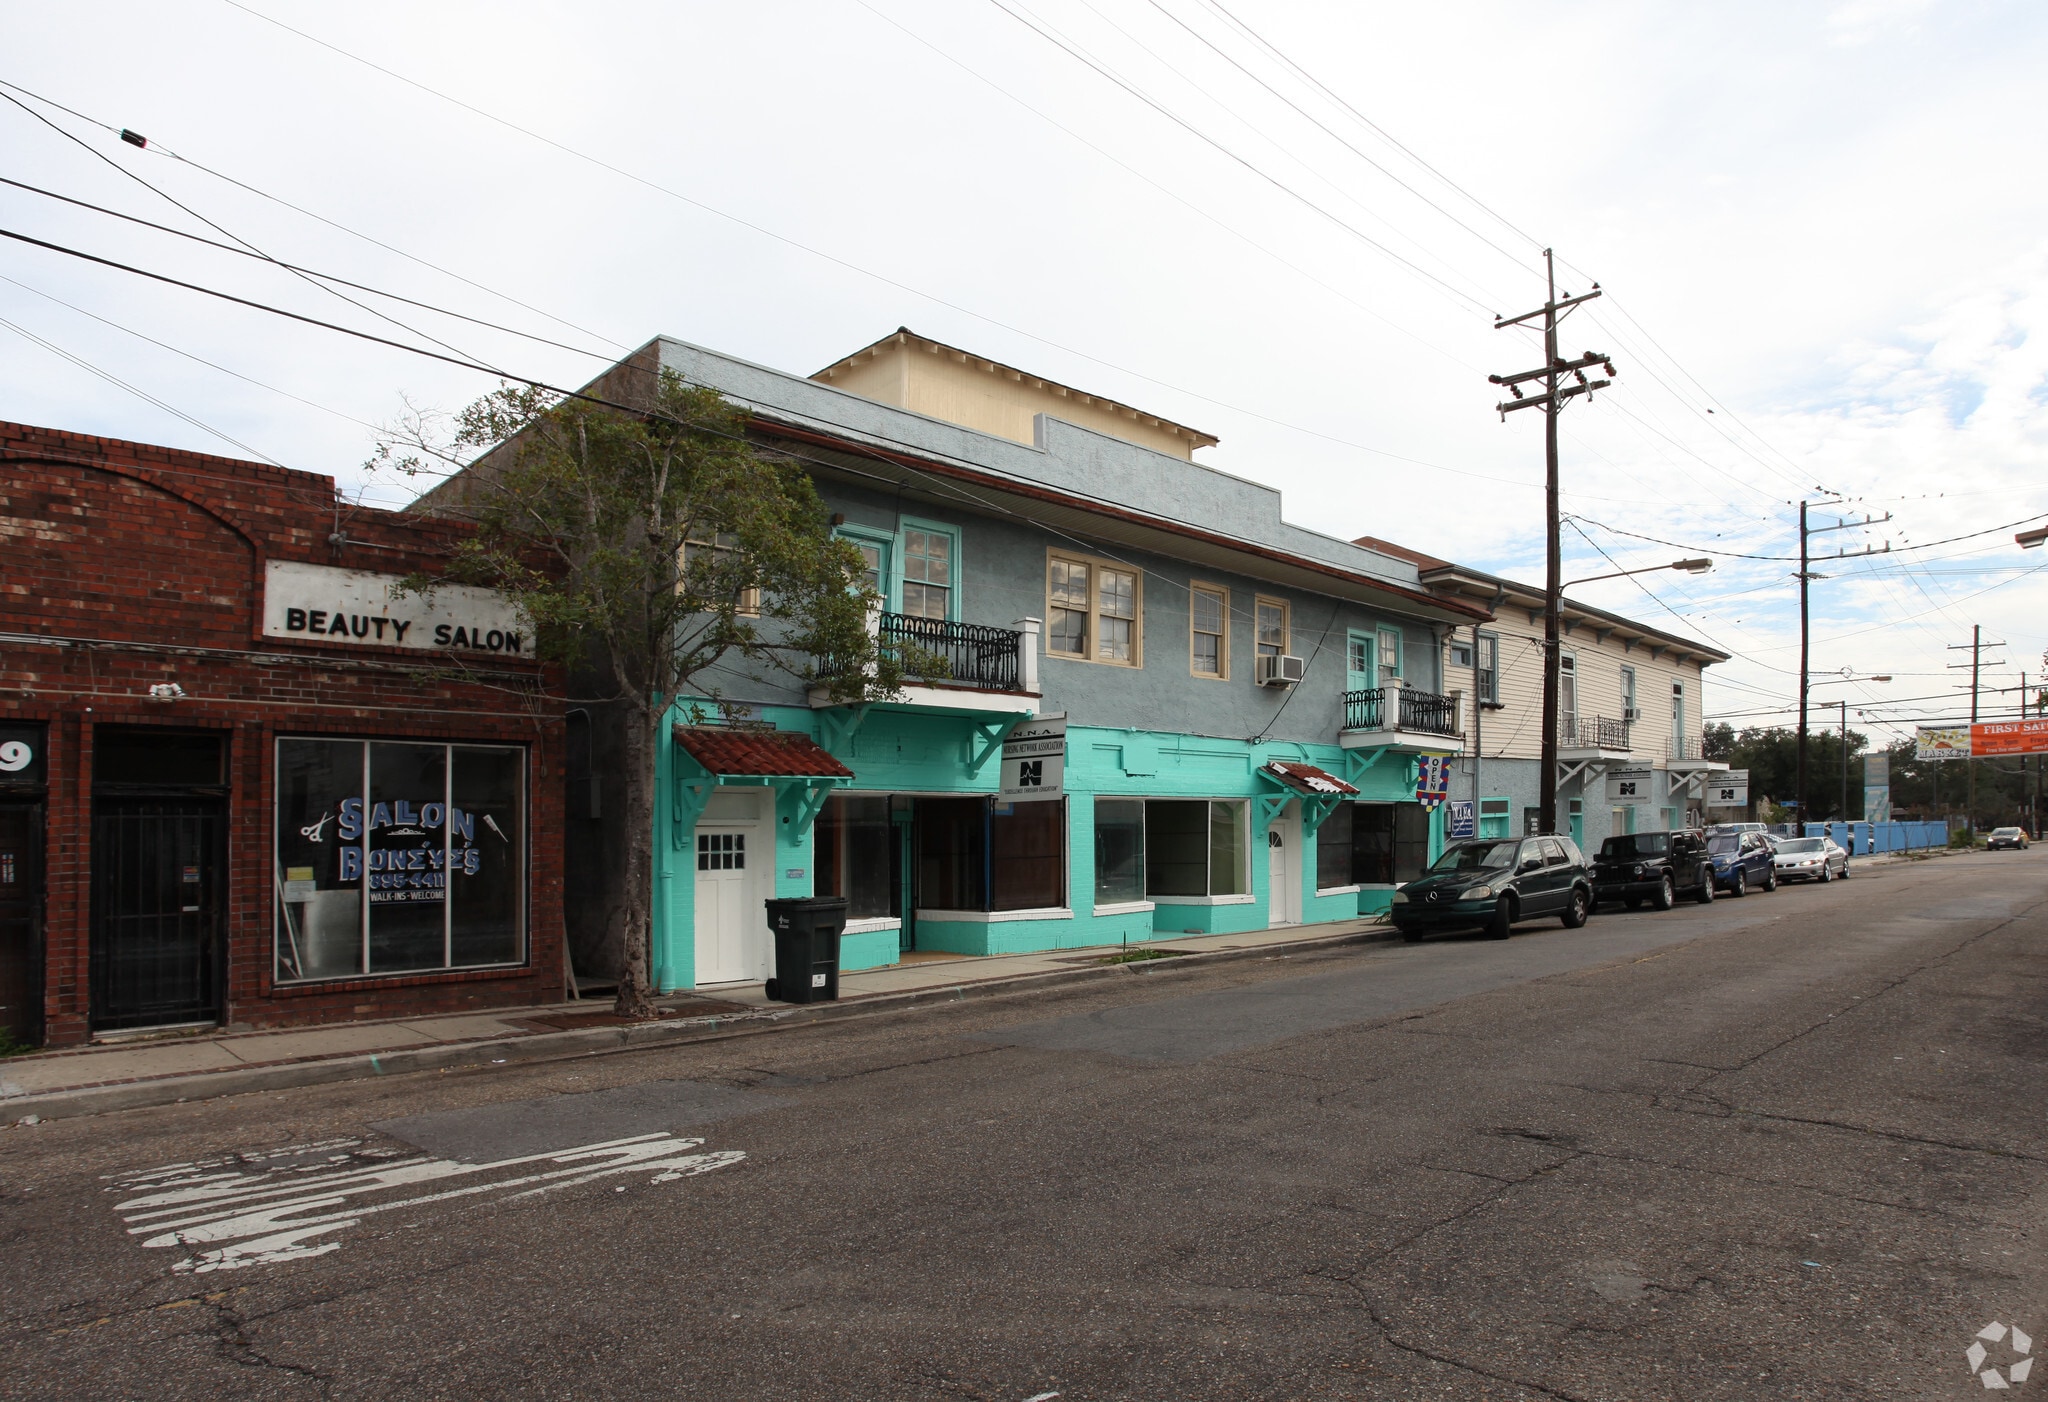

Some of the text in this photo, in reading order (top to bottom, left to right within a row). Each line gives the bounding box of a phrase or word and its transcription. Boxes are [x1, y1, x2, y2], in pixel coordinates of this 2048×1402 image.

[286, 607, 521, 651] BEAUTY SALON
[1013, 729, 1057, 738] N.N.A.
[1983, 724, 2019, 735] FIRST
[1038, 741, 1064, 752] ASSOCIATION
[1919, 748, 1969, 758] MARKET
[0, 741, 32, 771] 9
[1430, 758, 1440, 790] OPEN
[369, 872, 445, 890] 895-4411
